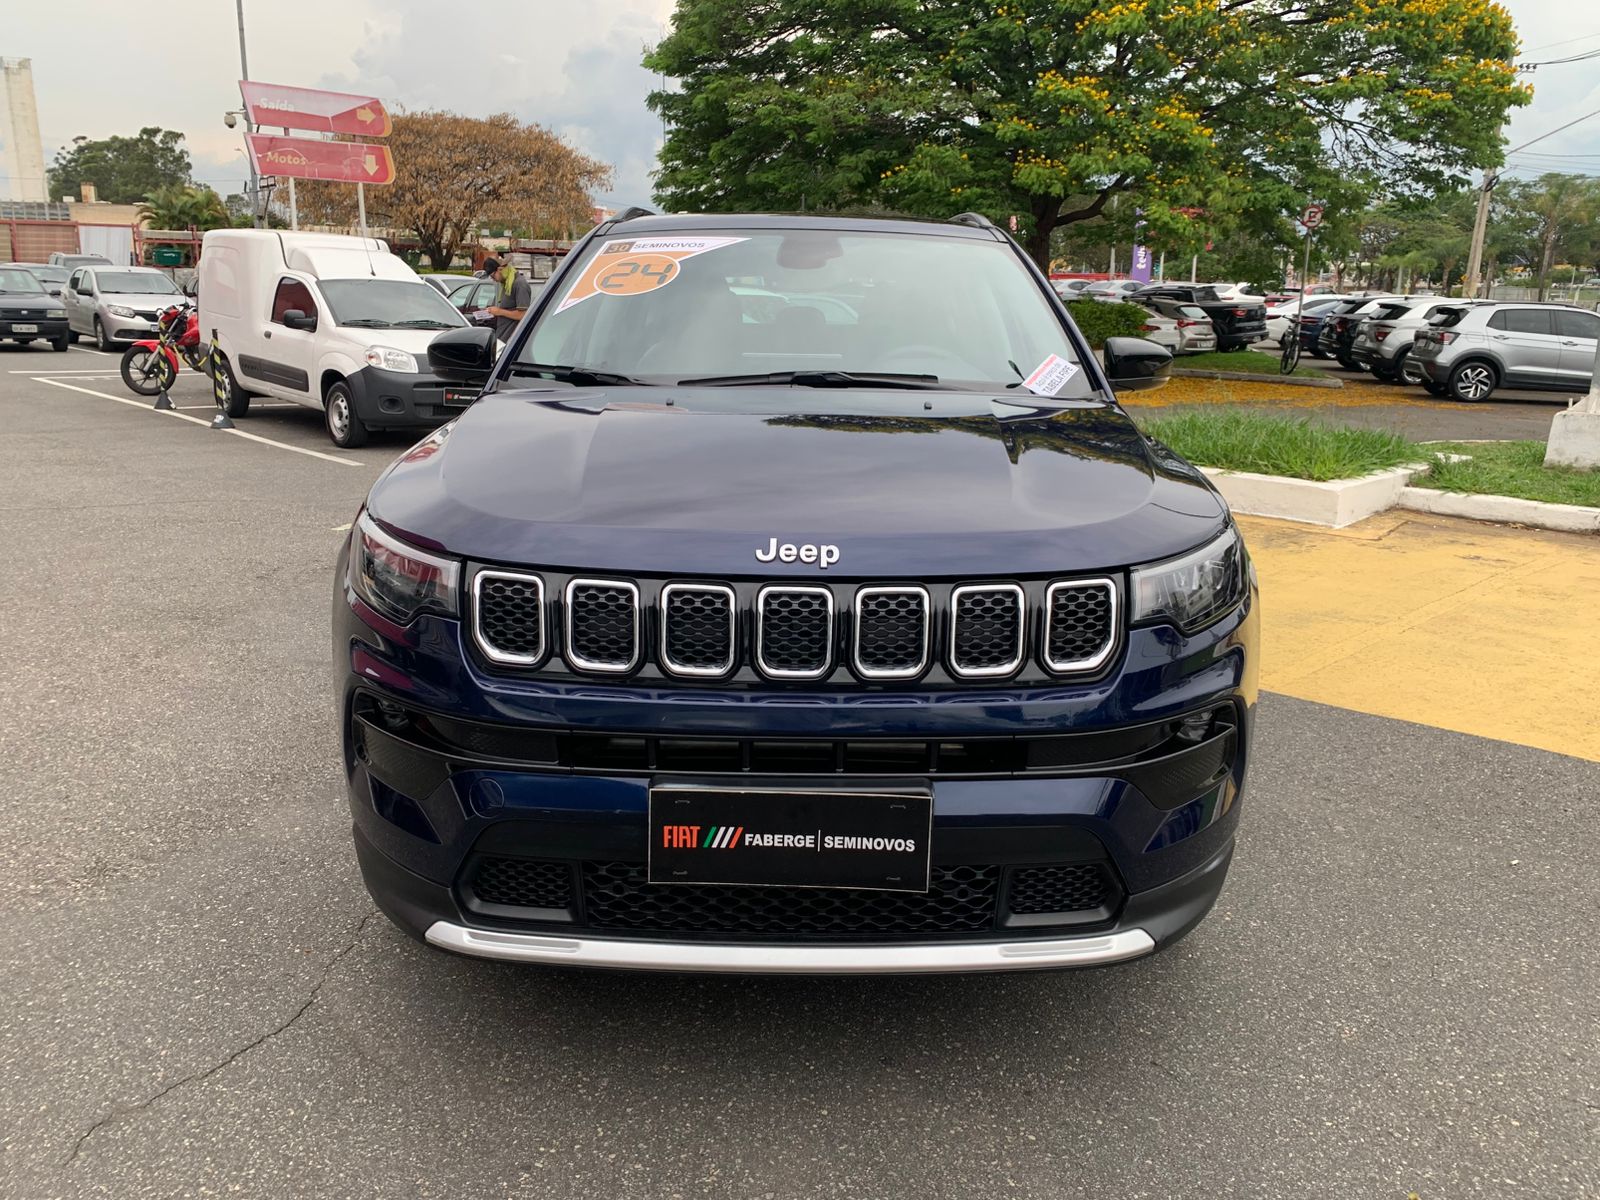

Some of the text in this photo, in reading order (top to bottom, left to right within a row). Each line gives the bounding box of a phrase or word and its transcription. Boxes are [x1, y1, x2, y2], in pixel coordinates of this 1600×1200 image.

[260, 97, 295, 113] Saída
[266, 151, 306, 166] Motos
[608, 243, 630, 253] 30
[601, 262, 674, 289] 24
[755, 537, 840, 568] Jeep
[663, 826, 916, 852] FIAT FABERGE SEMINOVOS
